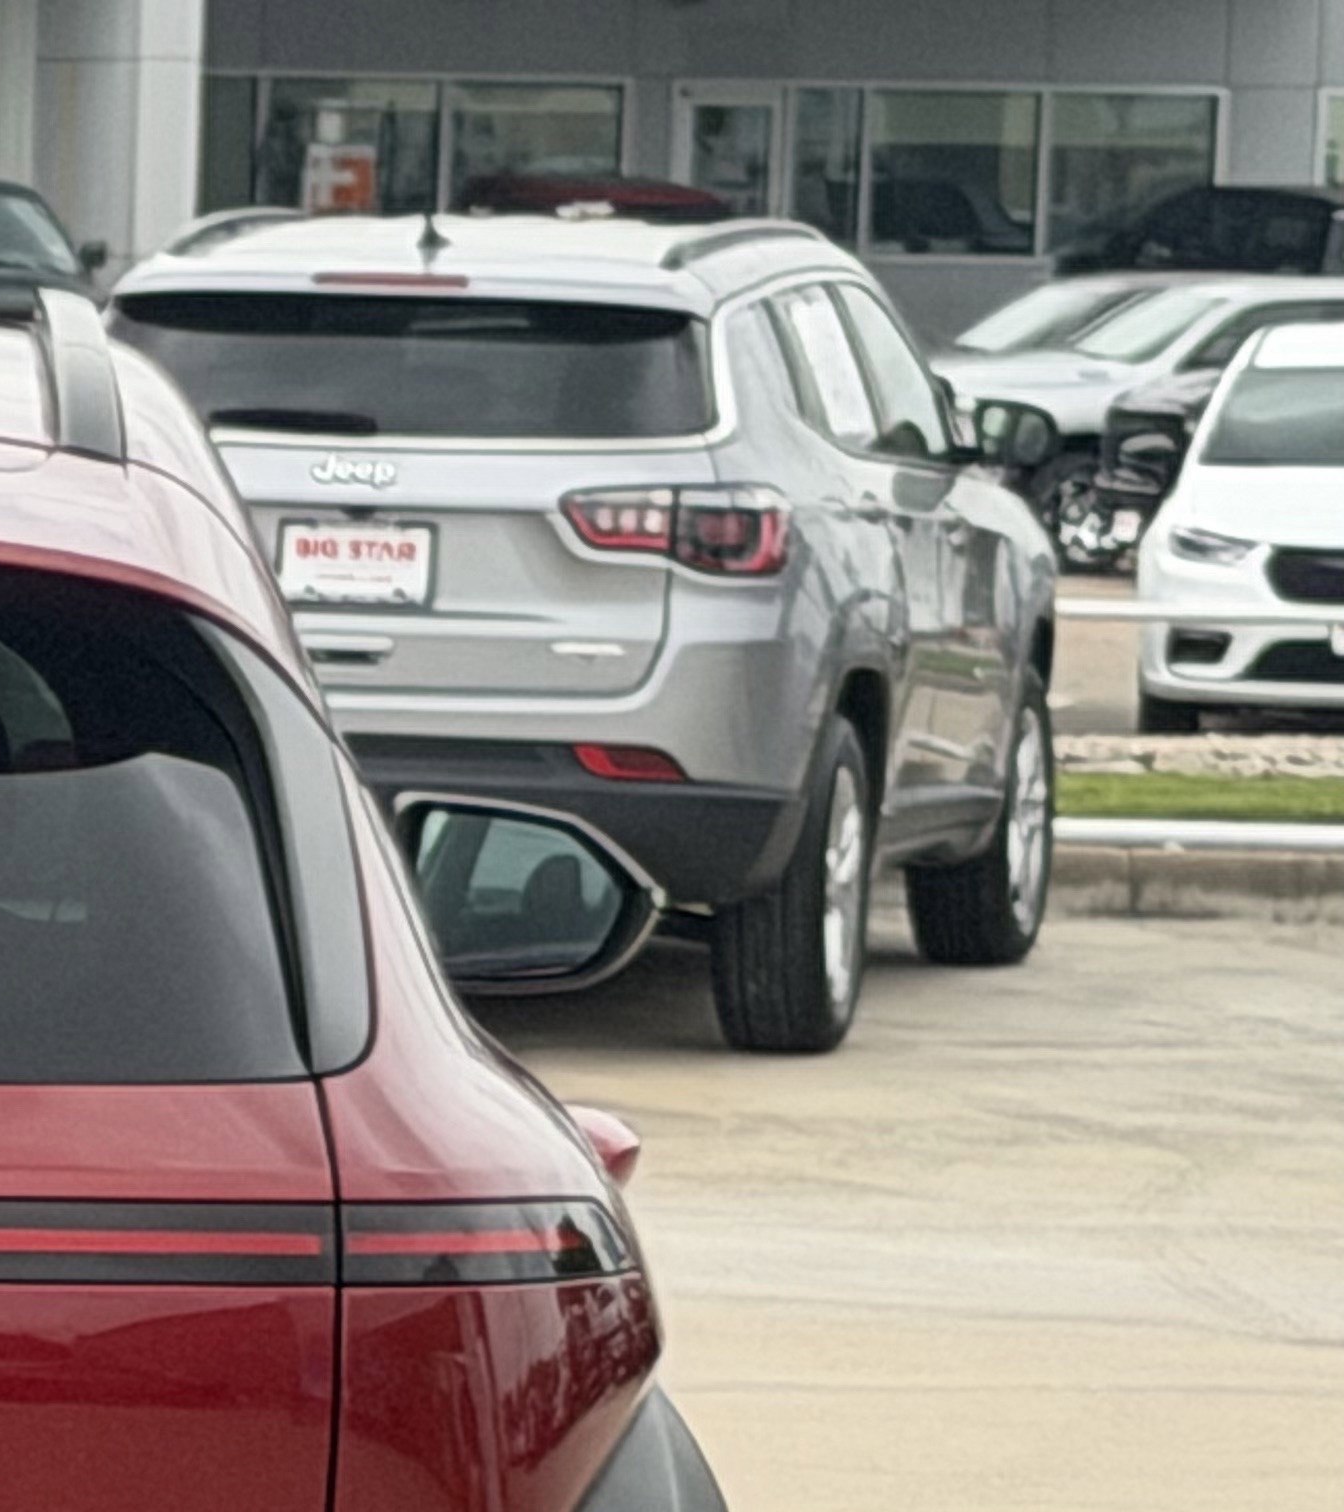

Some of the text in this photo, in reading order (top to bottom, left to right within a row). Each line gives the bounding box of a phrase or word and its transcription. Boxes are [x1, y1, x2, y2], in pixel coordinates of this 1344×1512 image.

[311, 452, 397, 487] Jeep
[296, 538, 417, 561] BIG STAR
